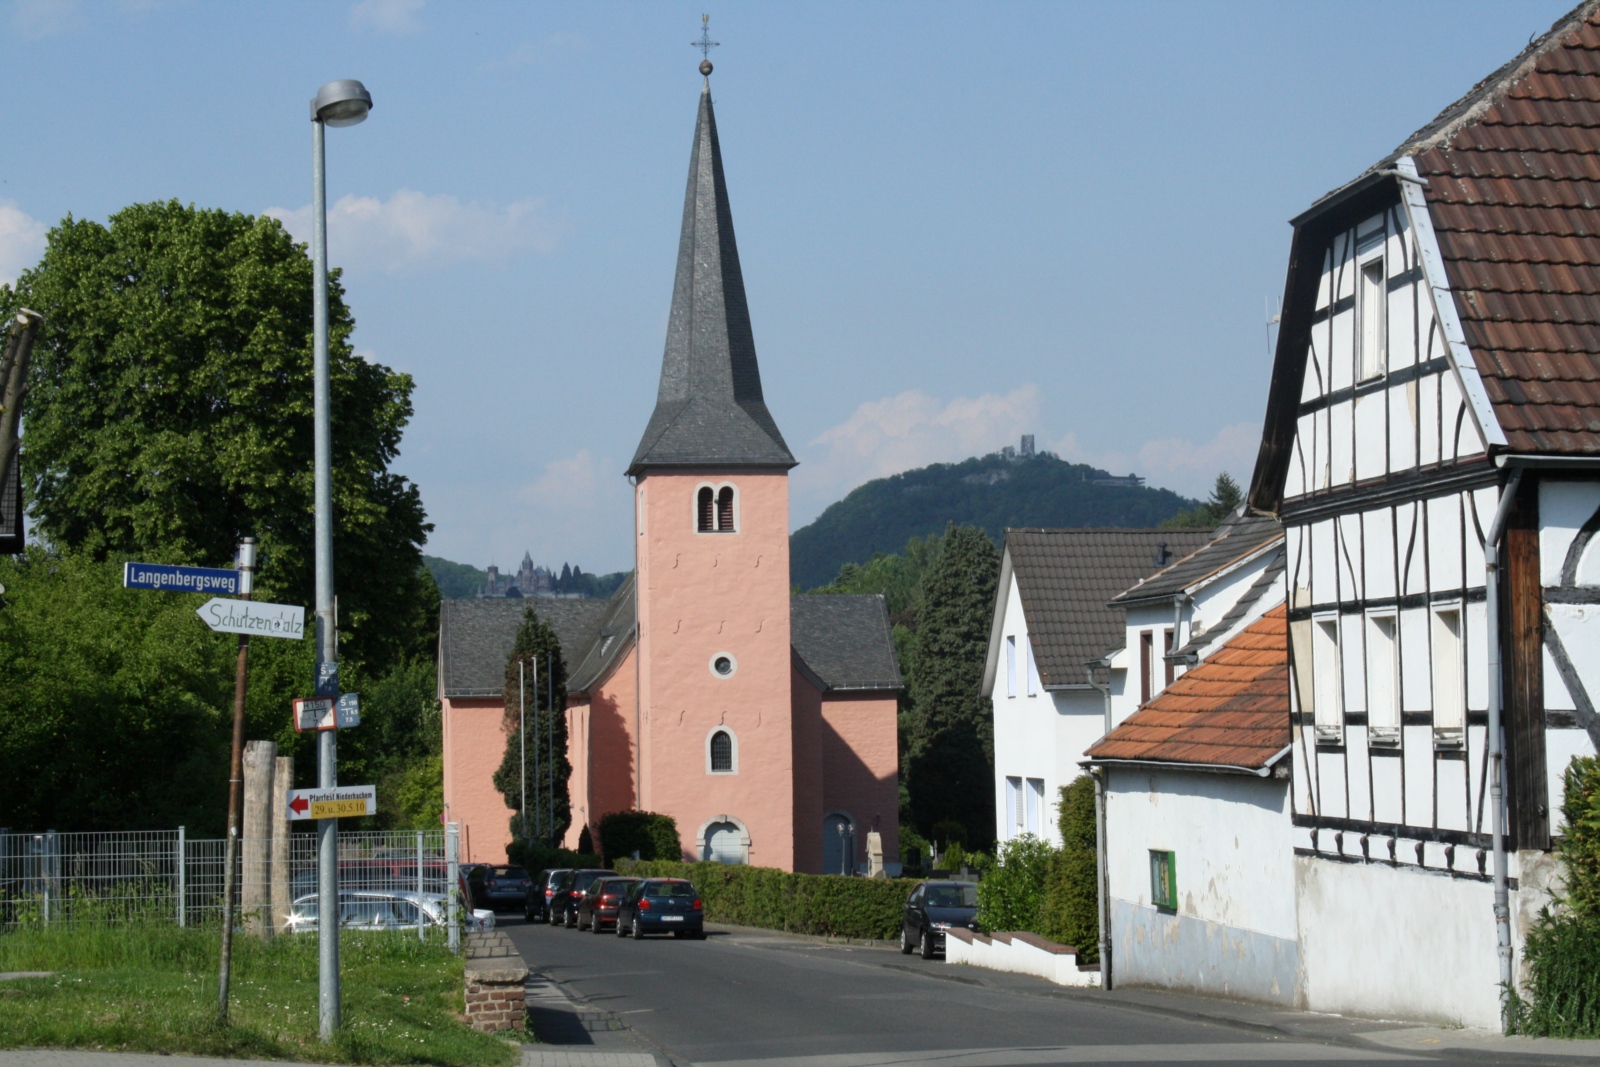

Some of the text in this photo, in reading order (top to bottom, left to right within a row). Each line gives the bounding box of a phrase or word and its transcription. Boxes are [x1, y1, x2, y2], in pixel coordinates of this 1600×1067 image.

[131, 567, 236, 593] Langenbergsweg
[309, 791, 372, 802] Pfarrfest Niederbachem
